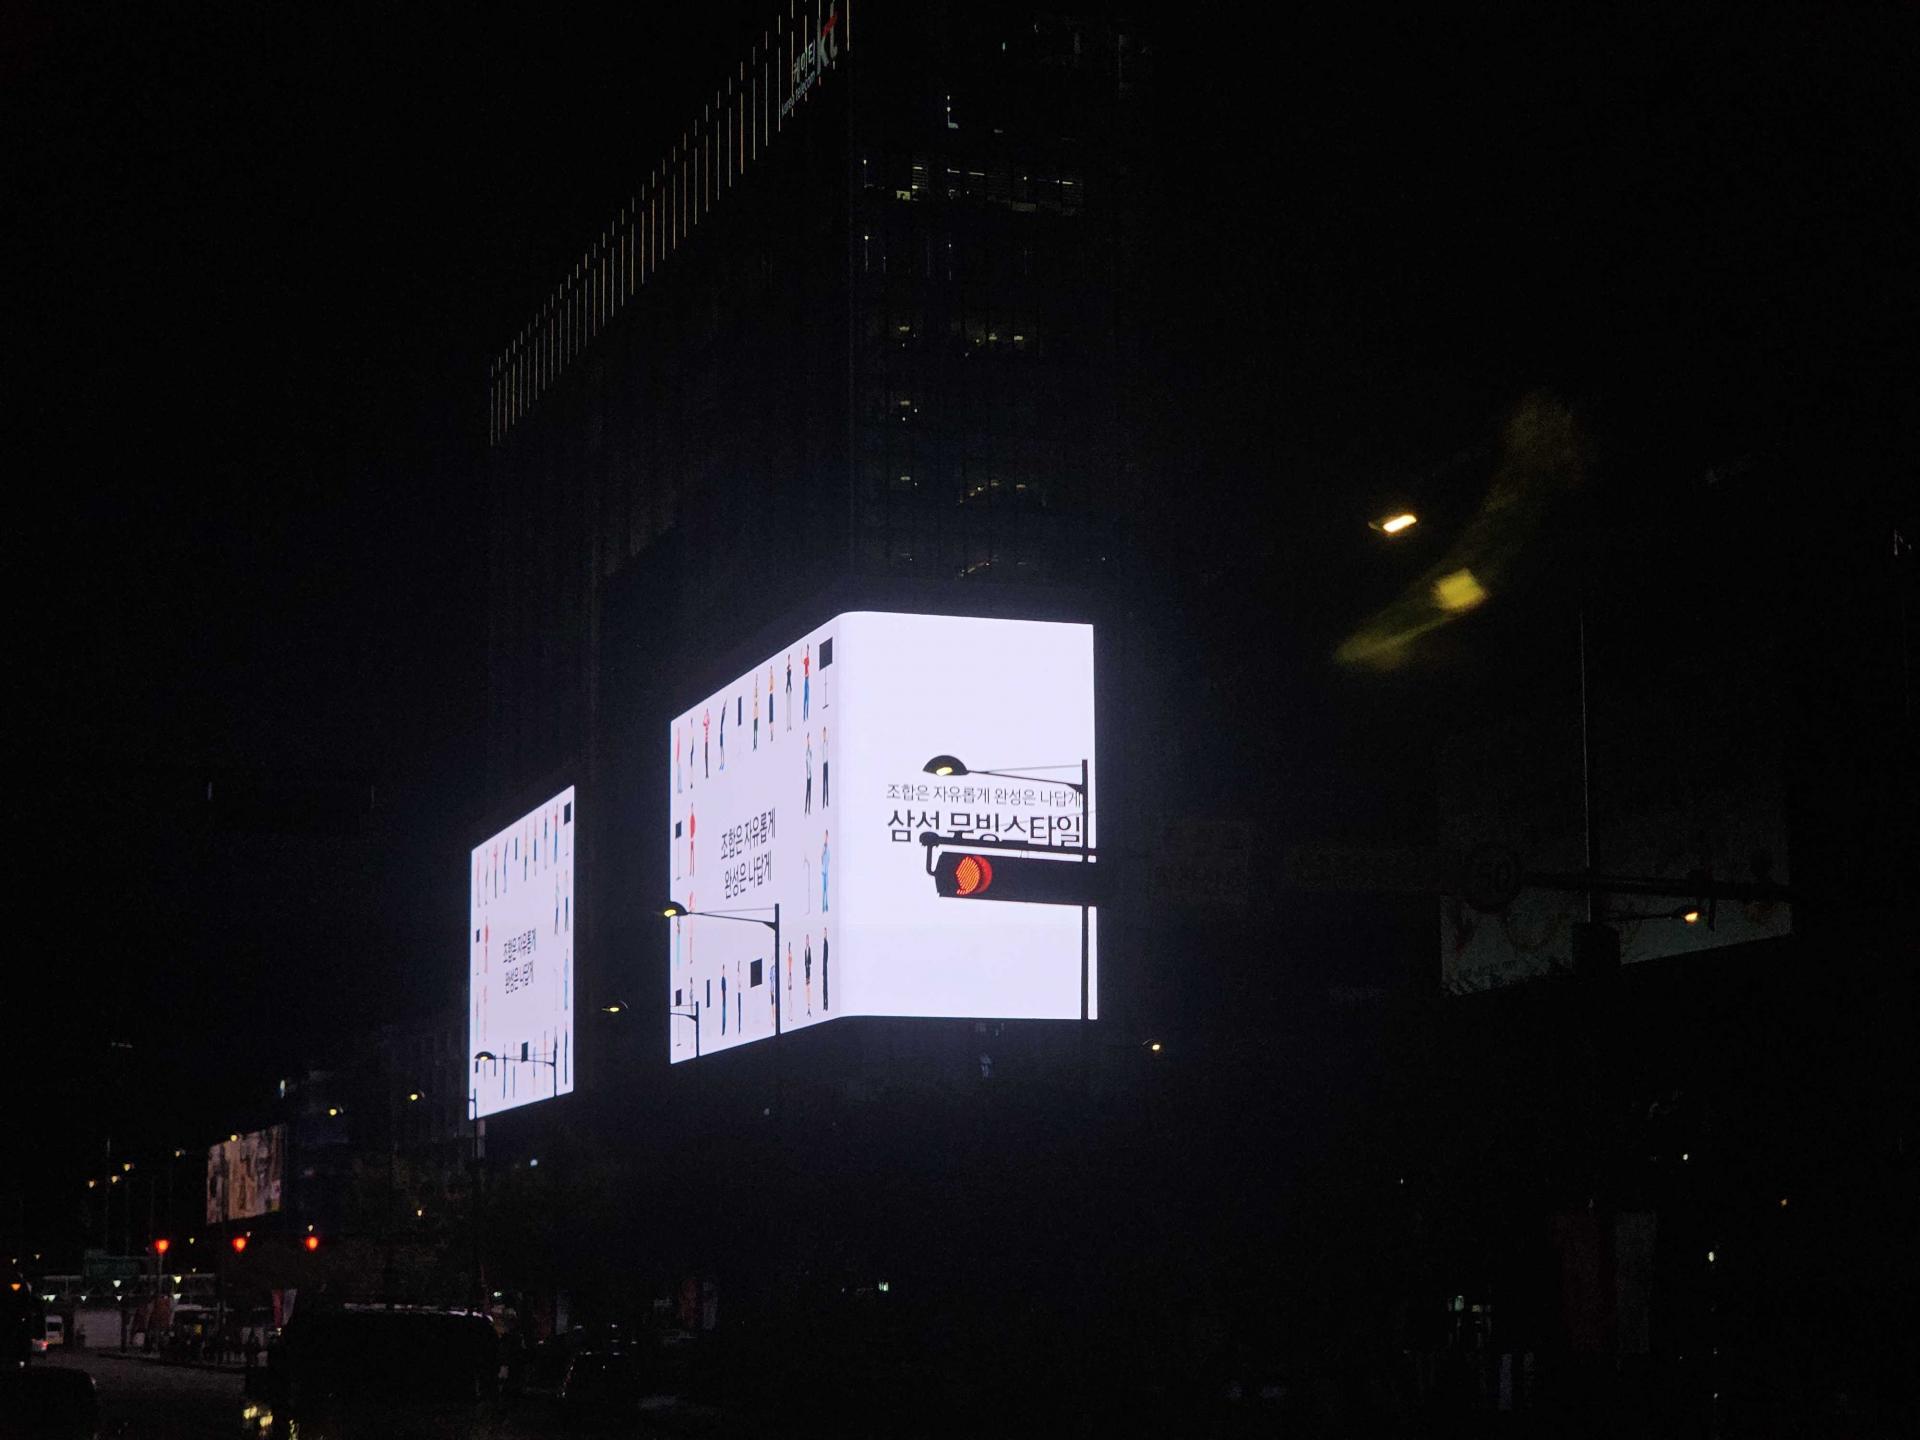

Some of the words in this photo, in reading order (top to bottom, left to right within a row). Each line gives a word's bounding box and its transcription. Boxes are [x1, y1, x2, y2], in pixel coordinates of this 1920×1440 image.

[886, 783, 930, 802] 조합은
[934, 784, 990, 804] 자유롭게
[994, 788, 1036, 807] 완성은
[1040, 789, 1082, 808] 나답게
[720, 824, 743, 860] 조합은
[744, 807, 776, 850] 자유롭게
[947, 812, 1081, 848] 무빙스타일
[724, 862, 747, 899] 완성은
[748, 850, 772, 888] 나답게
